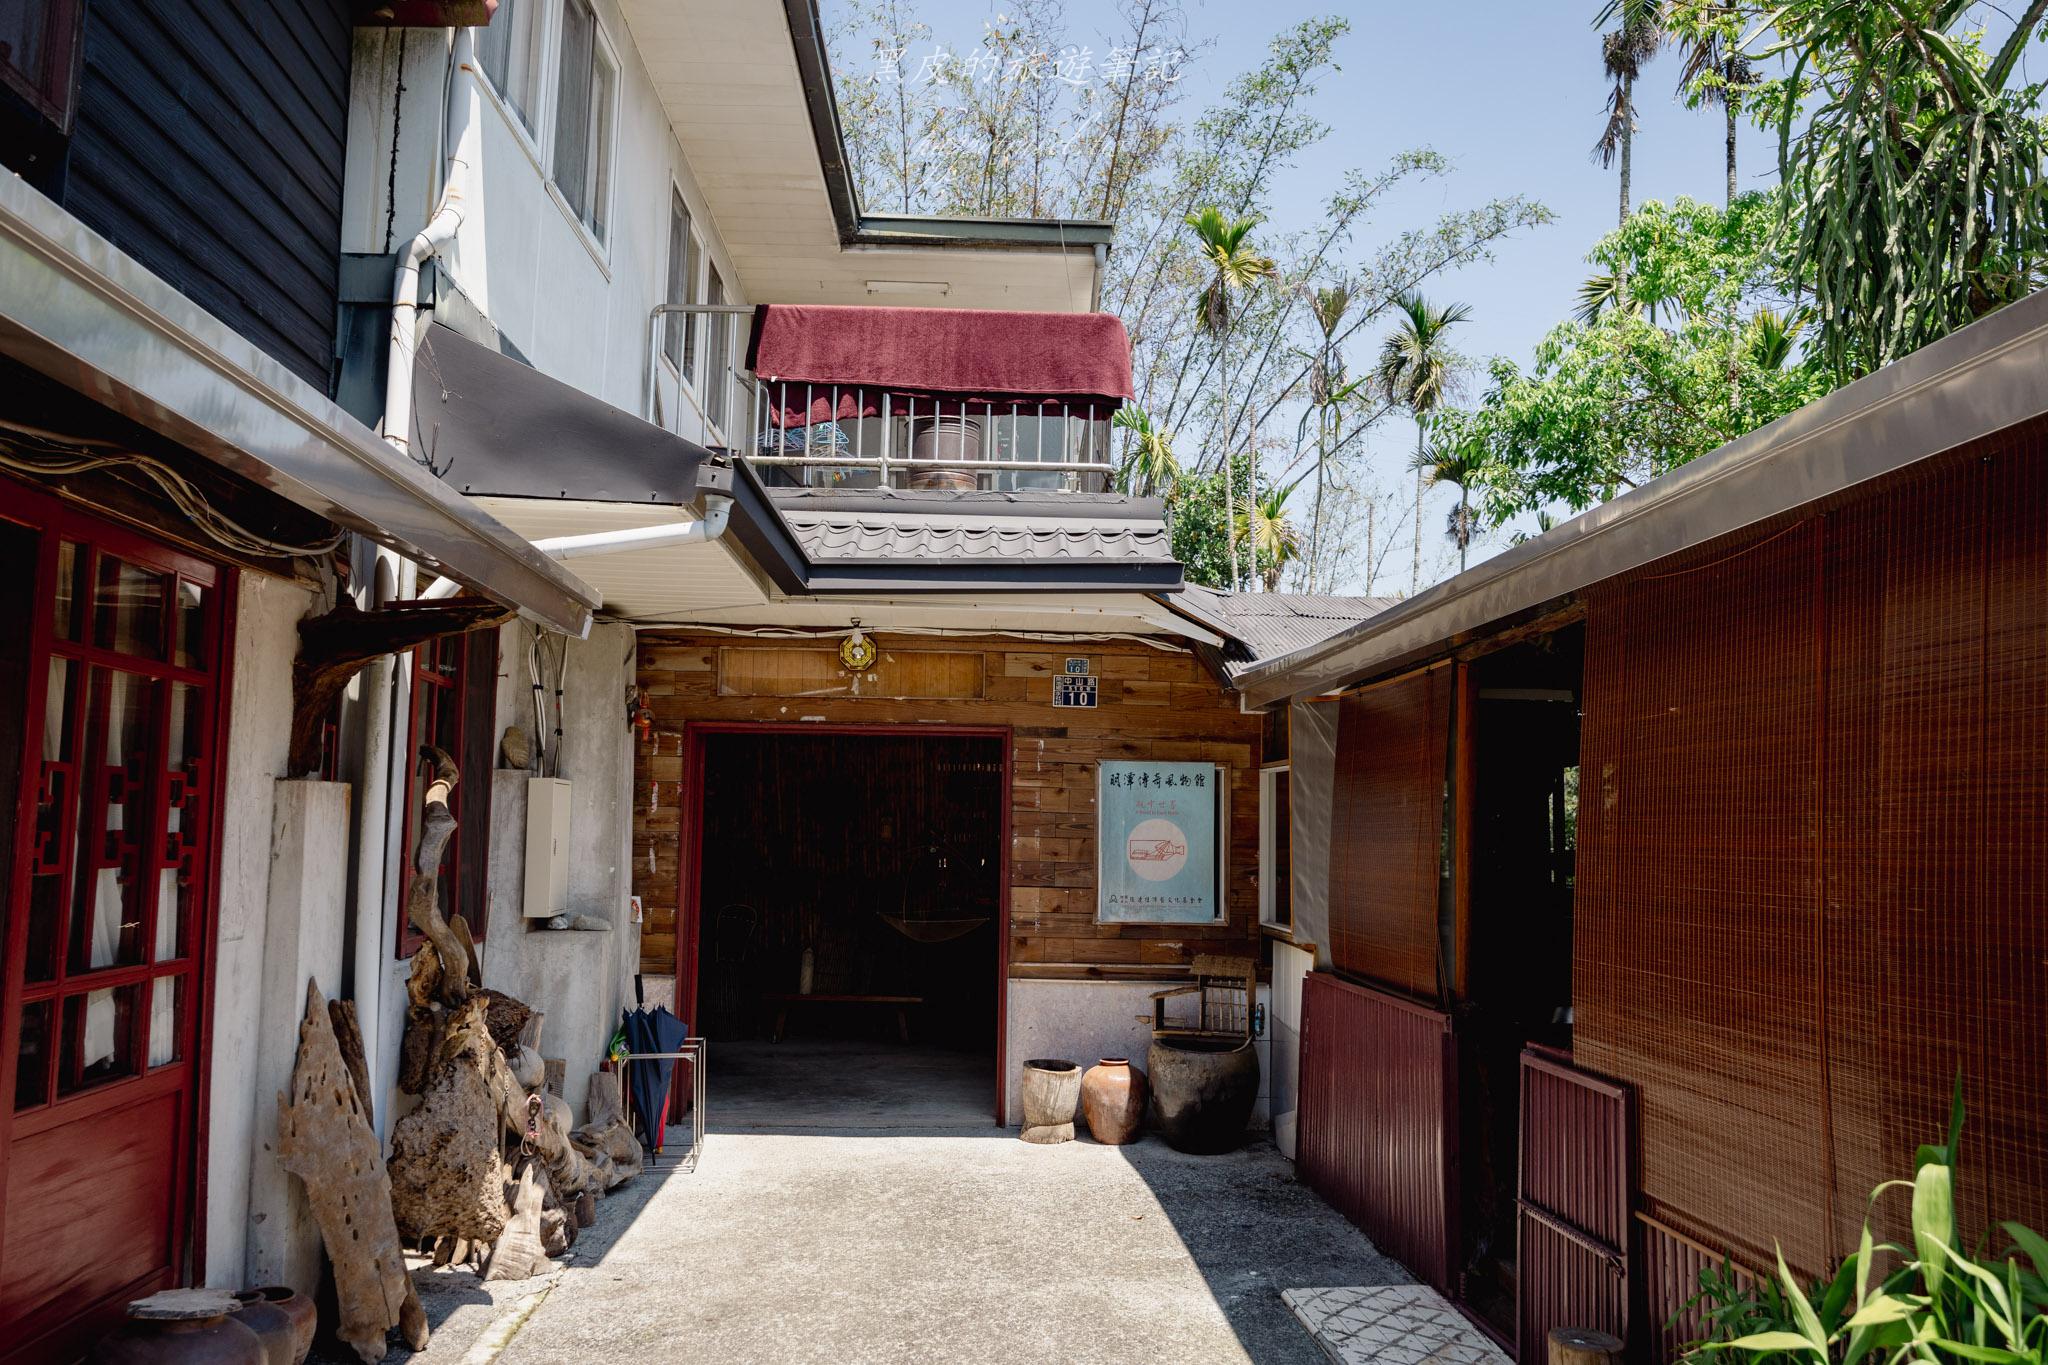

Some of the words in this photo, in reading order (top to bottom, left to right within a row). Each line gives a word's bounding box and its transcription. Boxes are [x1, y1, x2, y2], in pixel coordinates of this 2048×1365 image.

[1064, 677, 1095, 686] 中山路
[1069, 692, 1087, 706] 10
